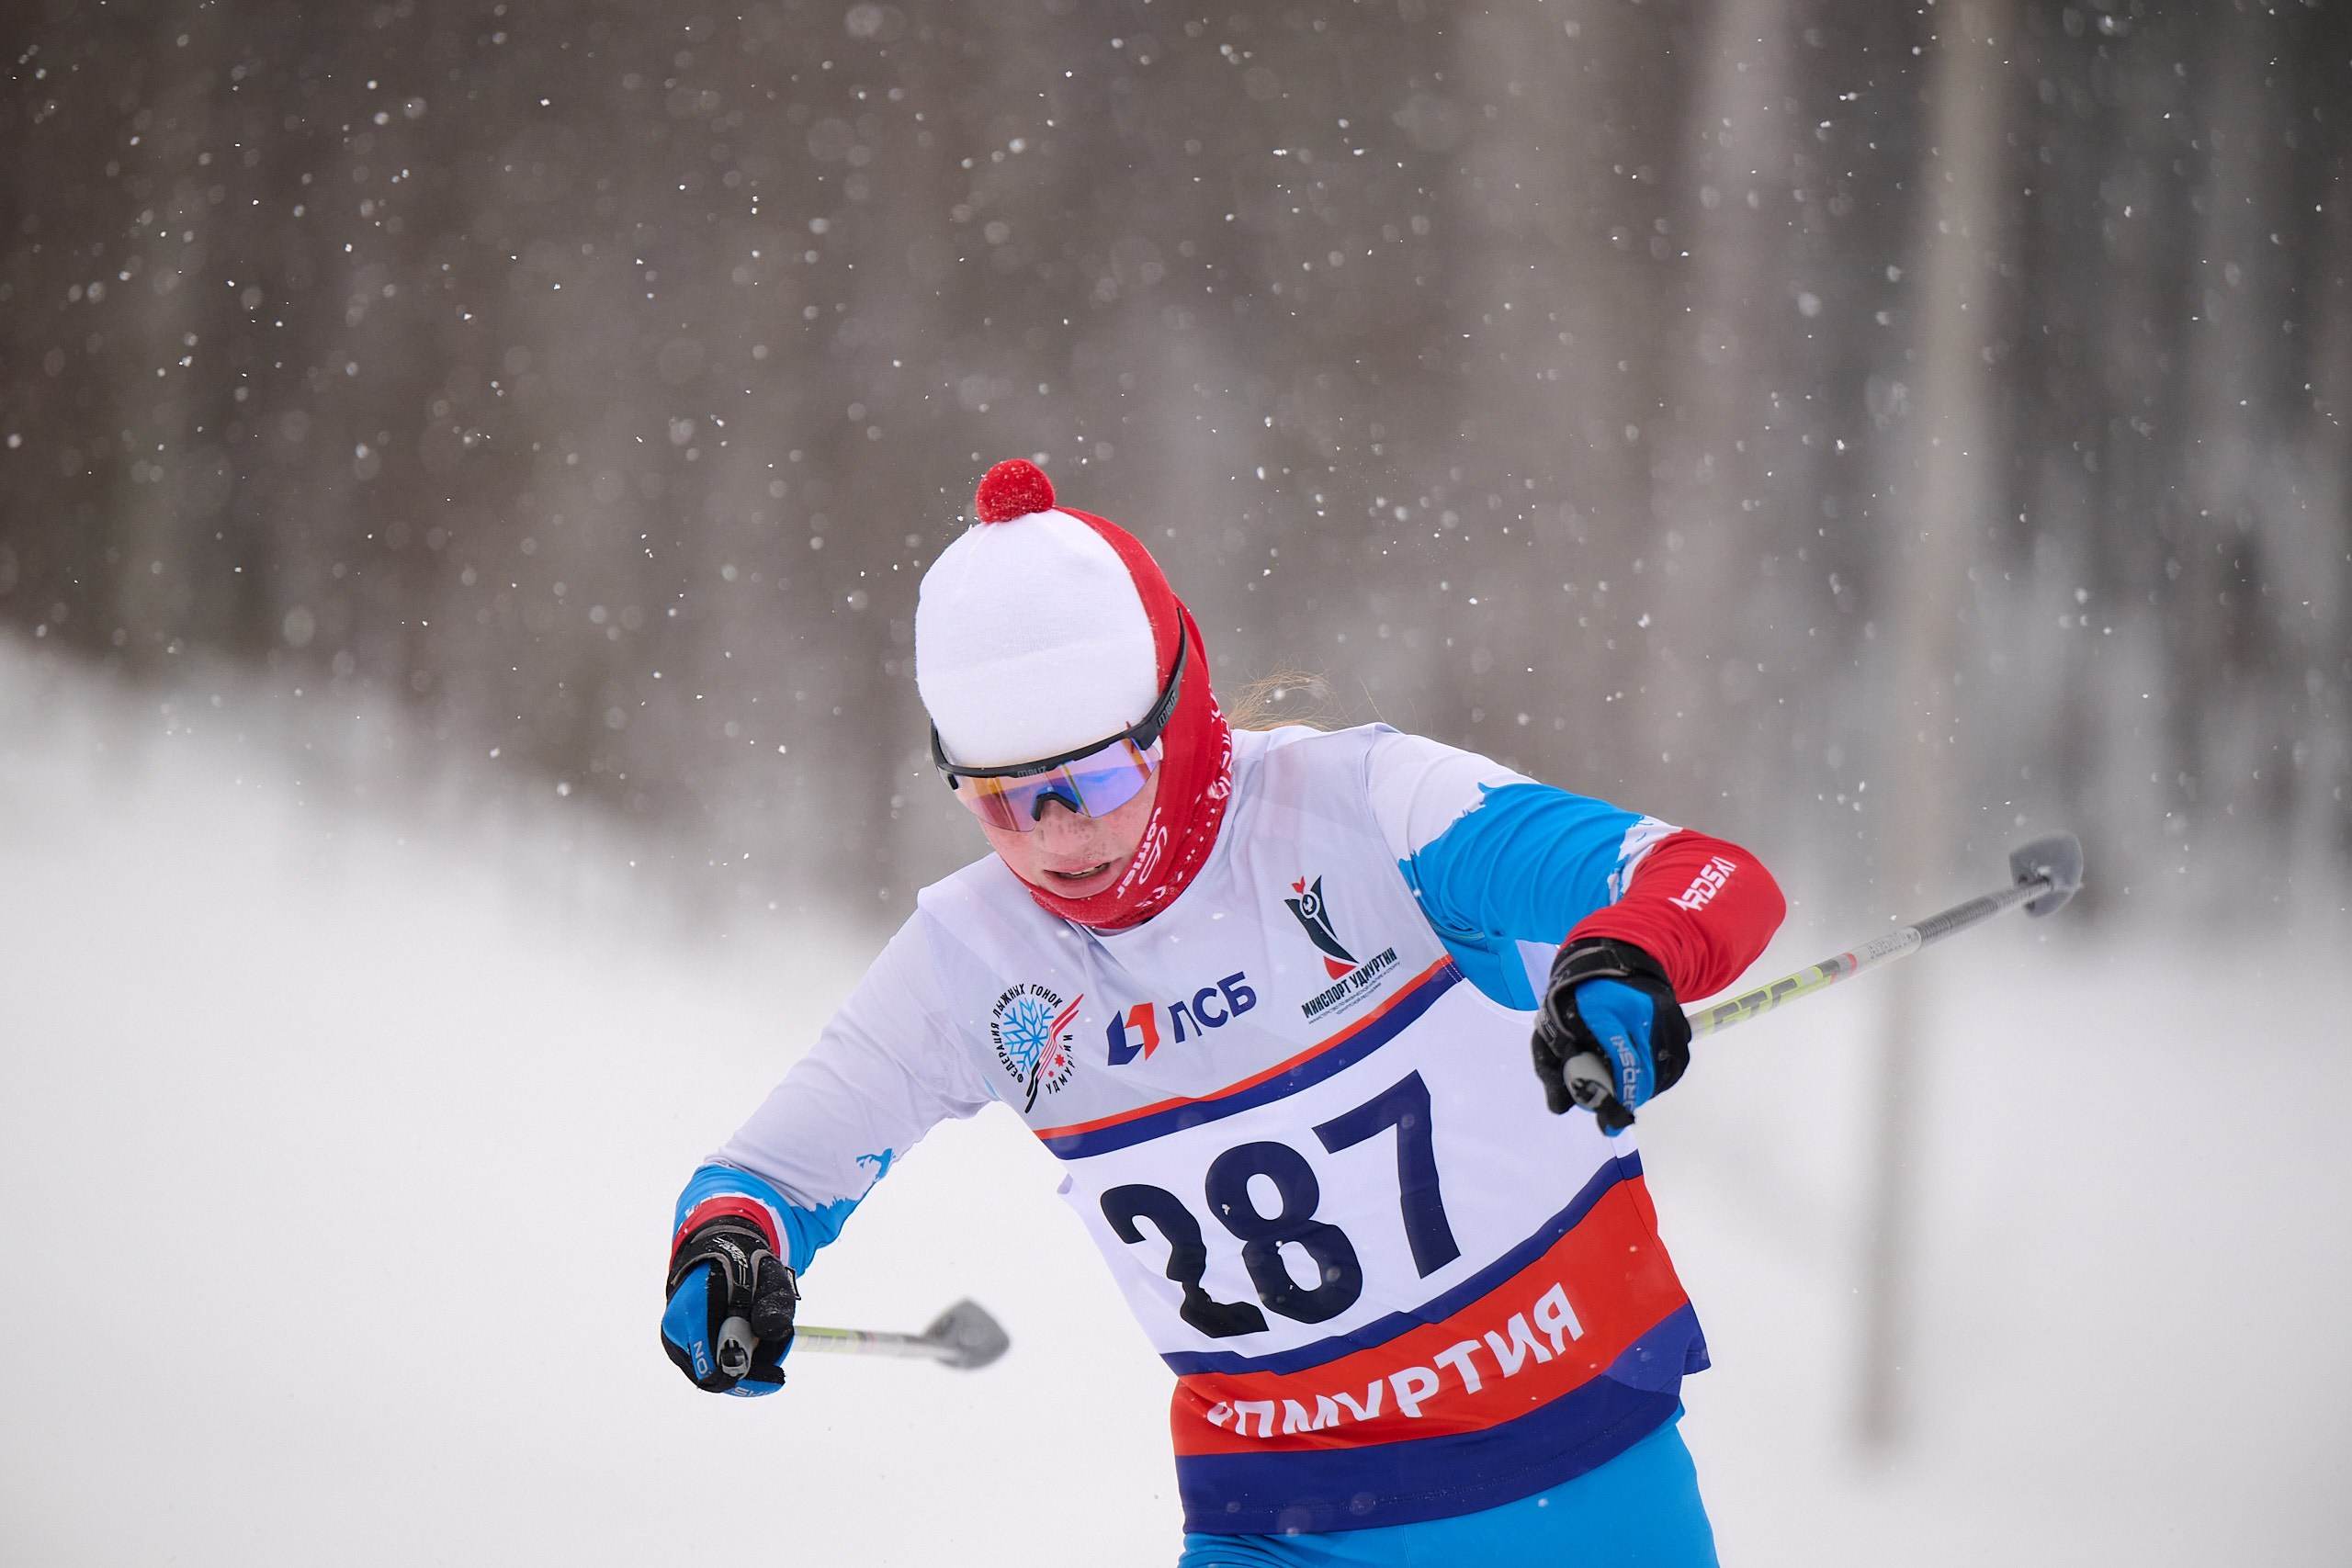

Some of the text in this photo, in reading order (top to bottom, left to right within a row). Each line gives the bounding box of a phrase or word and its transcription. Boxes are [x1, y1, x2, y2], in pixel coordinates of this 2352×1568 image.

[1168, 971, 1257, 1043] ПСБ
[1301, 947, 1397, 1019] МИНСПОРТ УДМУРТИИ
[990, 983, 1064, 1083] ФЕДЕРАЦИЯ ЛЫЖНЫХ ГОНОК
[1100, 1069, 1461, 1338] 287
